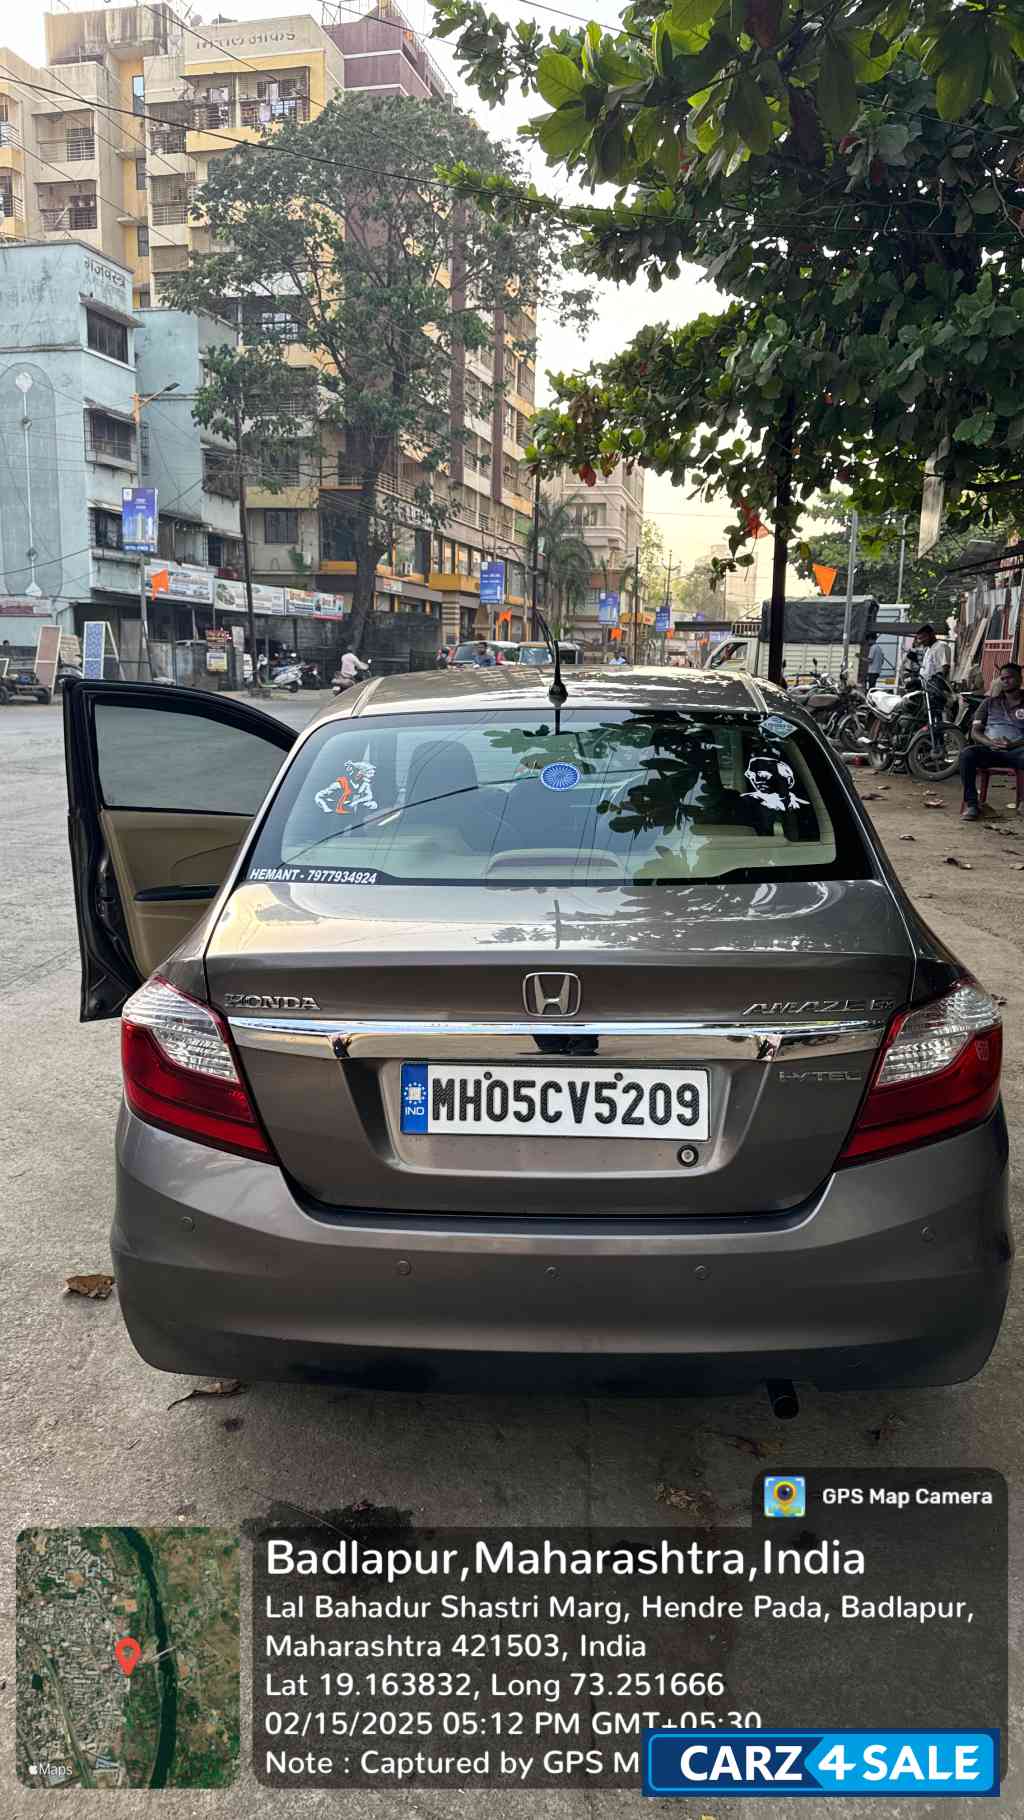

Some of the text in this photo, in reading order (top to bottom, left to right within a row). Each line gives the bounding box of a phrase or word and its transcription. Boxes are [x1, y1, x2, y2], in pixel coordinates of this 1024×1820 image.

[307, 870, 377, 885] 7977934924
[223, 993, 321, 1010] HONDA
[742, 999, 865, 1016] AMAZE
[405, 1106, 425, 1116] IND
[432, 1077, 700, 1128] MH05CV5209
